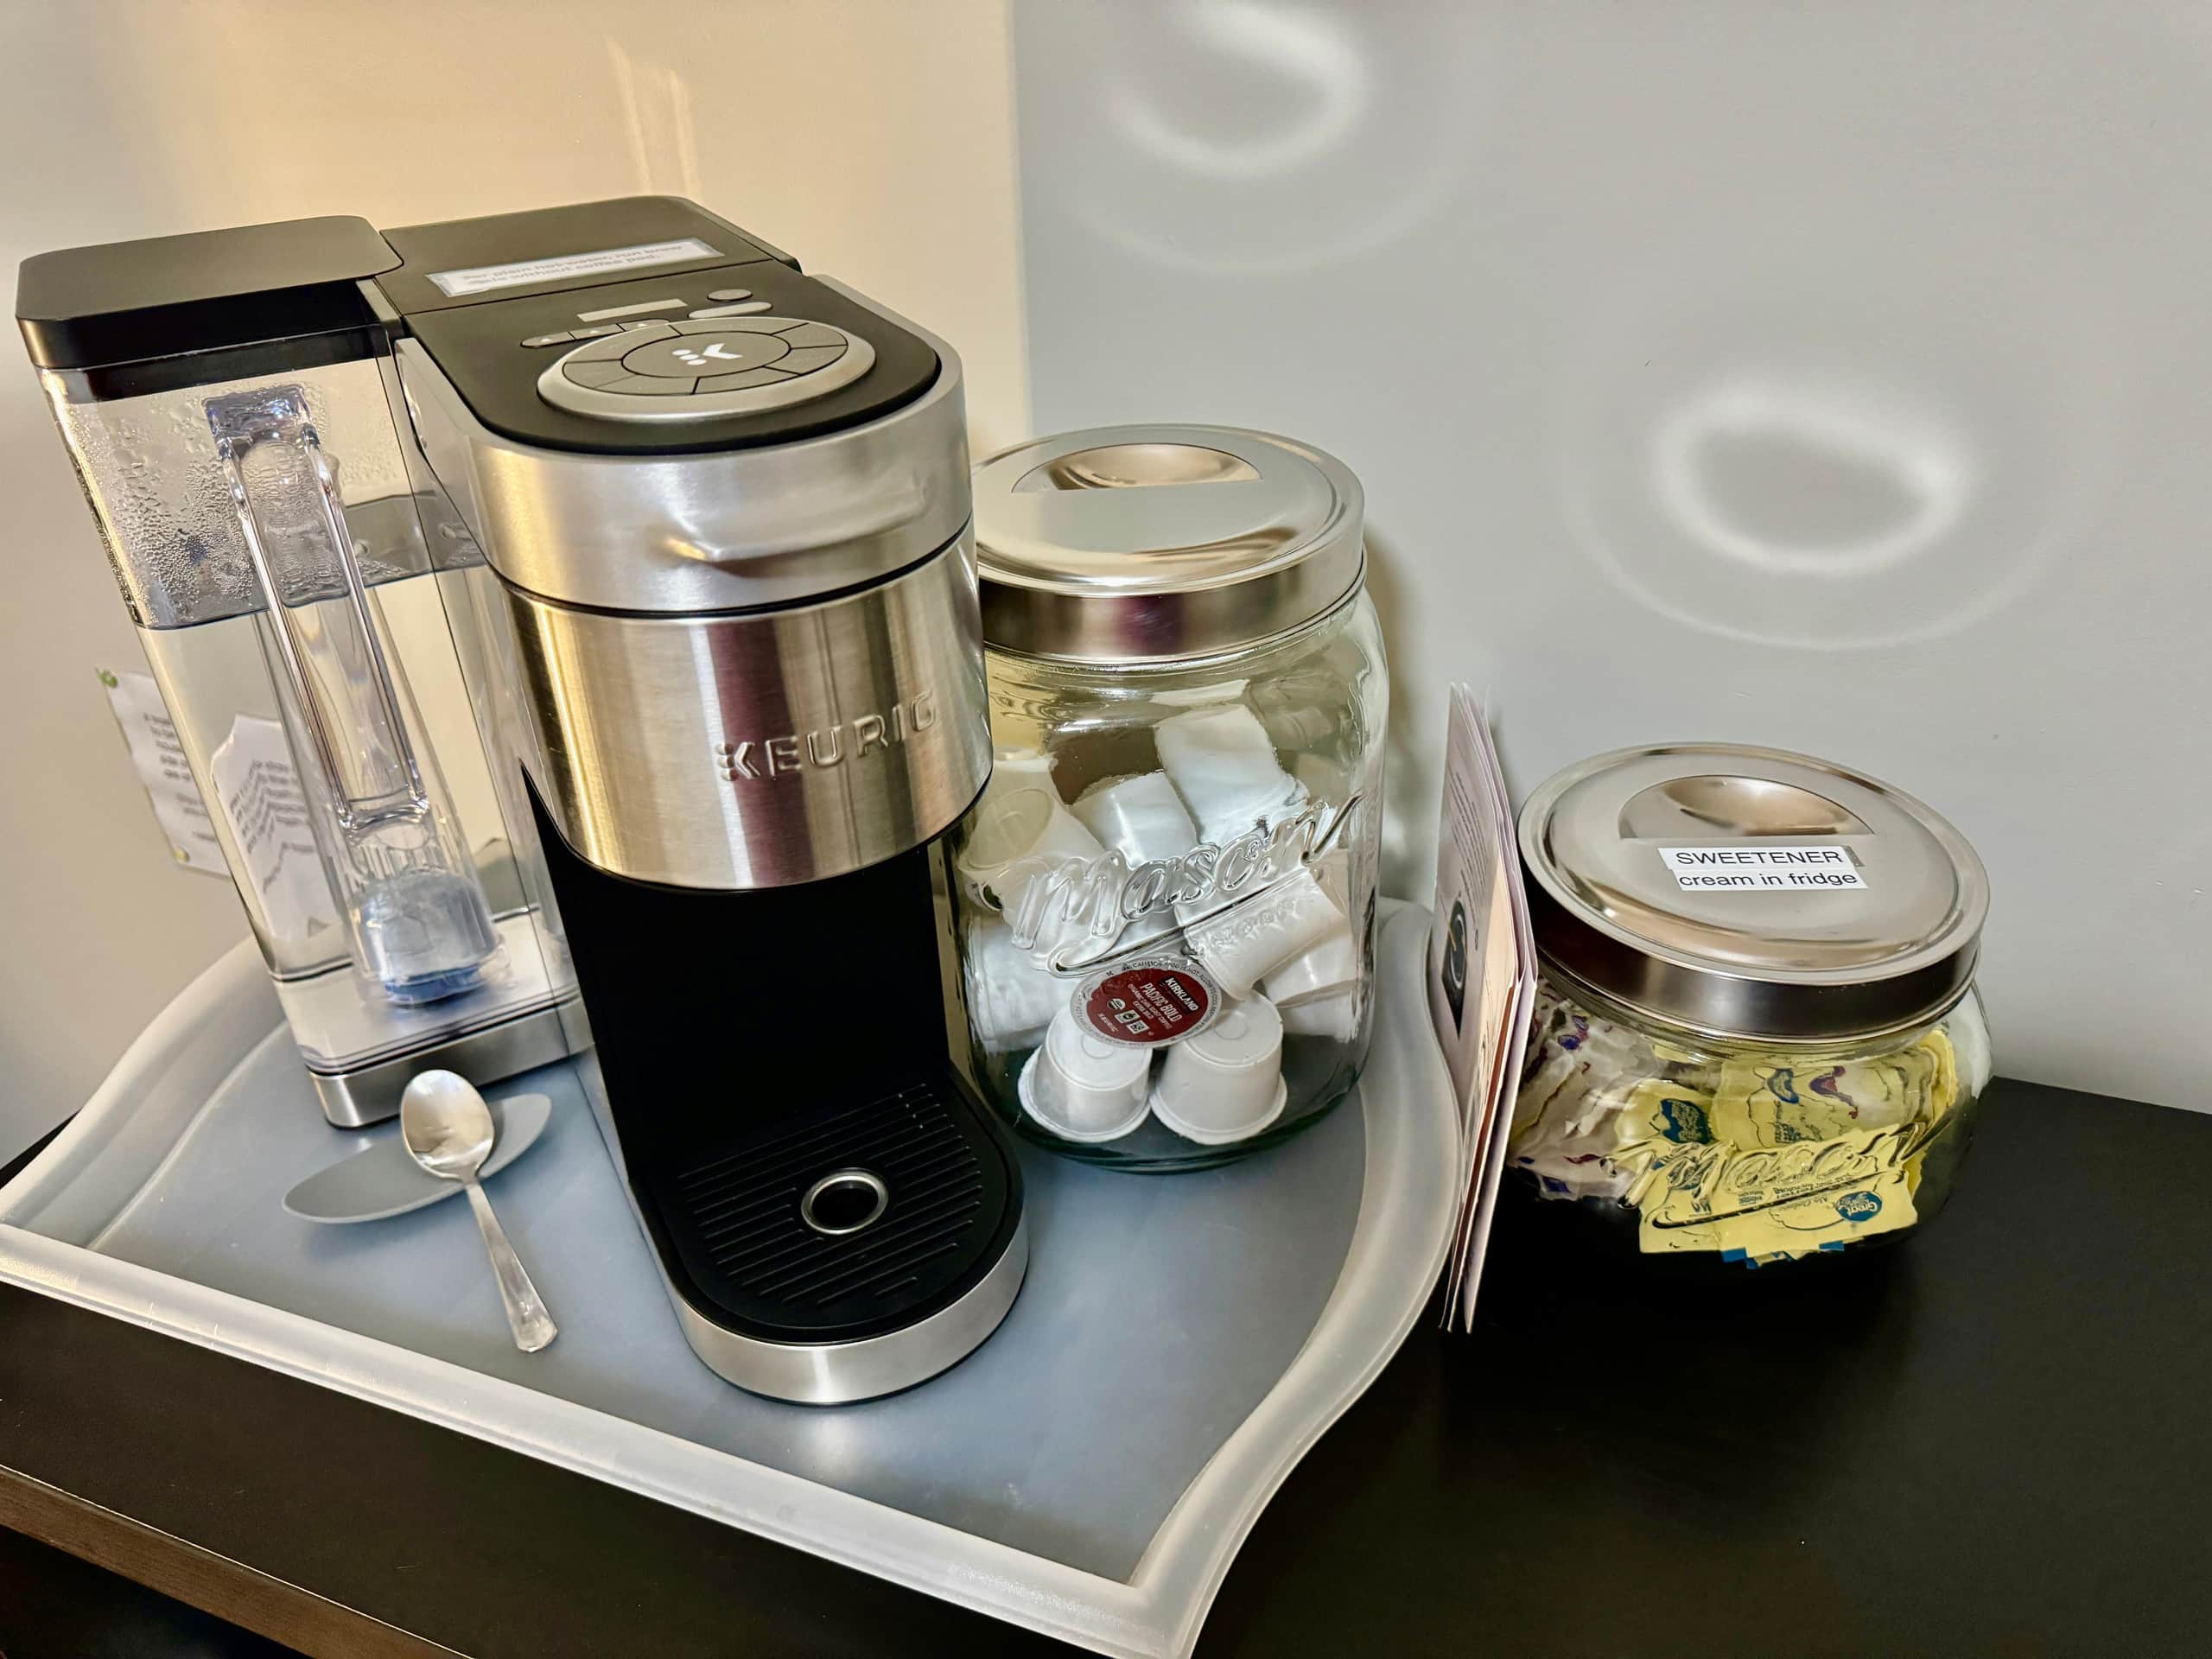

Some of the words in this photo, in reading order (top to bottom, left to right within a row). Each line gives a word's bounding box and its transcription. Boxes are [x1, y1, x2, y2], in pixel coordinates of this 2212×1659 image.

[715, 690, 938, 781] KEURIG
[1676, 851, 1843, 865] SWEETENER
[1679, 874, 1755, 887] cream
[1760, 874, 1783, 887] in
[1789, 873, 1858, 888] fridge
[1140, 982, 1168, 1007] PACIFIC
[1160, 1003, 1183, 1022] BOLD
[1165, 977, 1199, 1011] KIRKLAND
